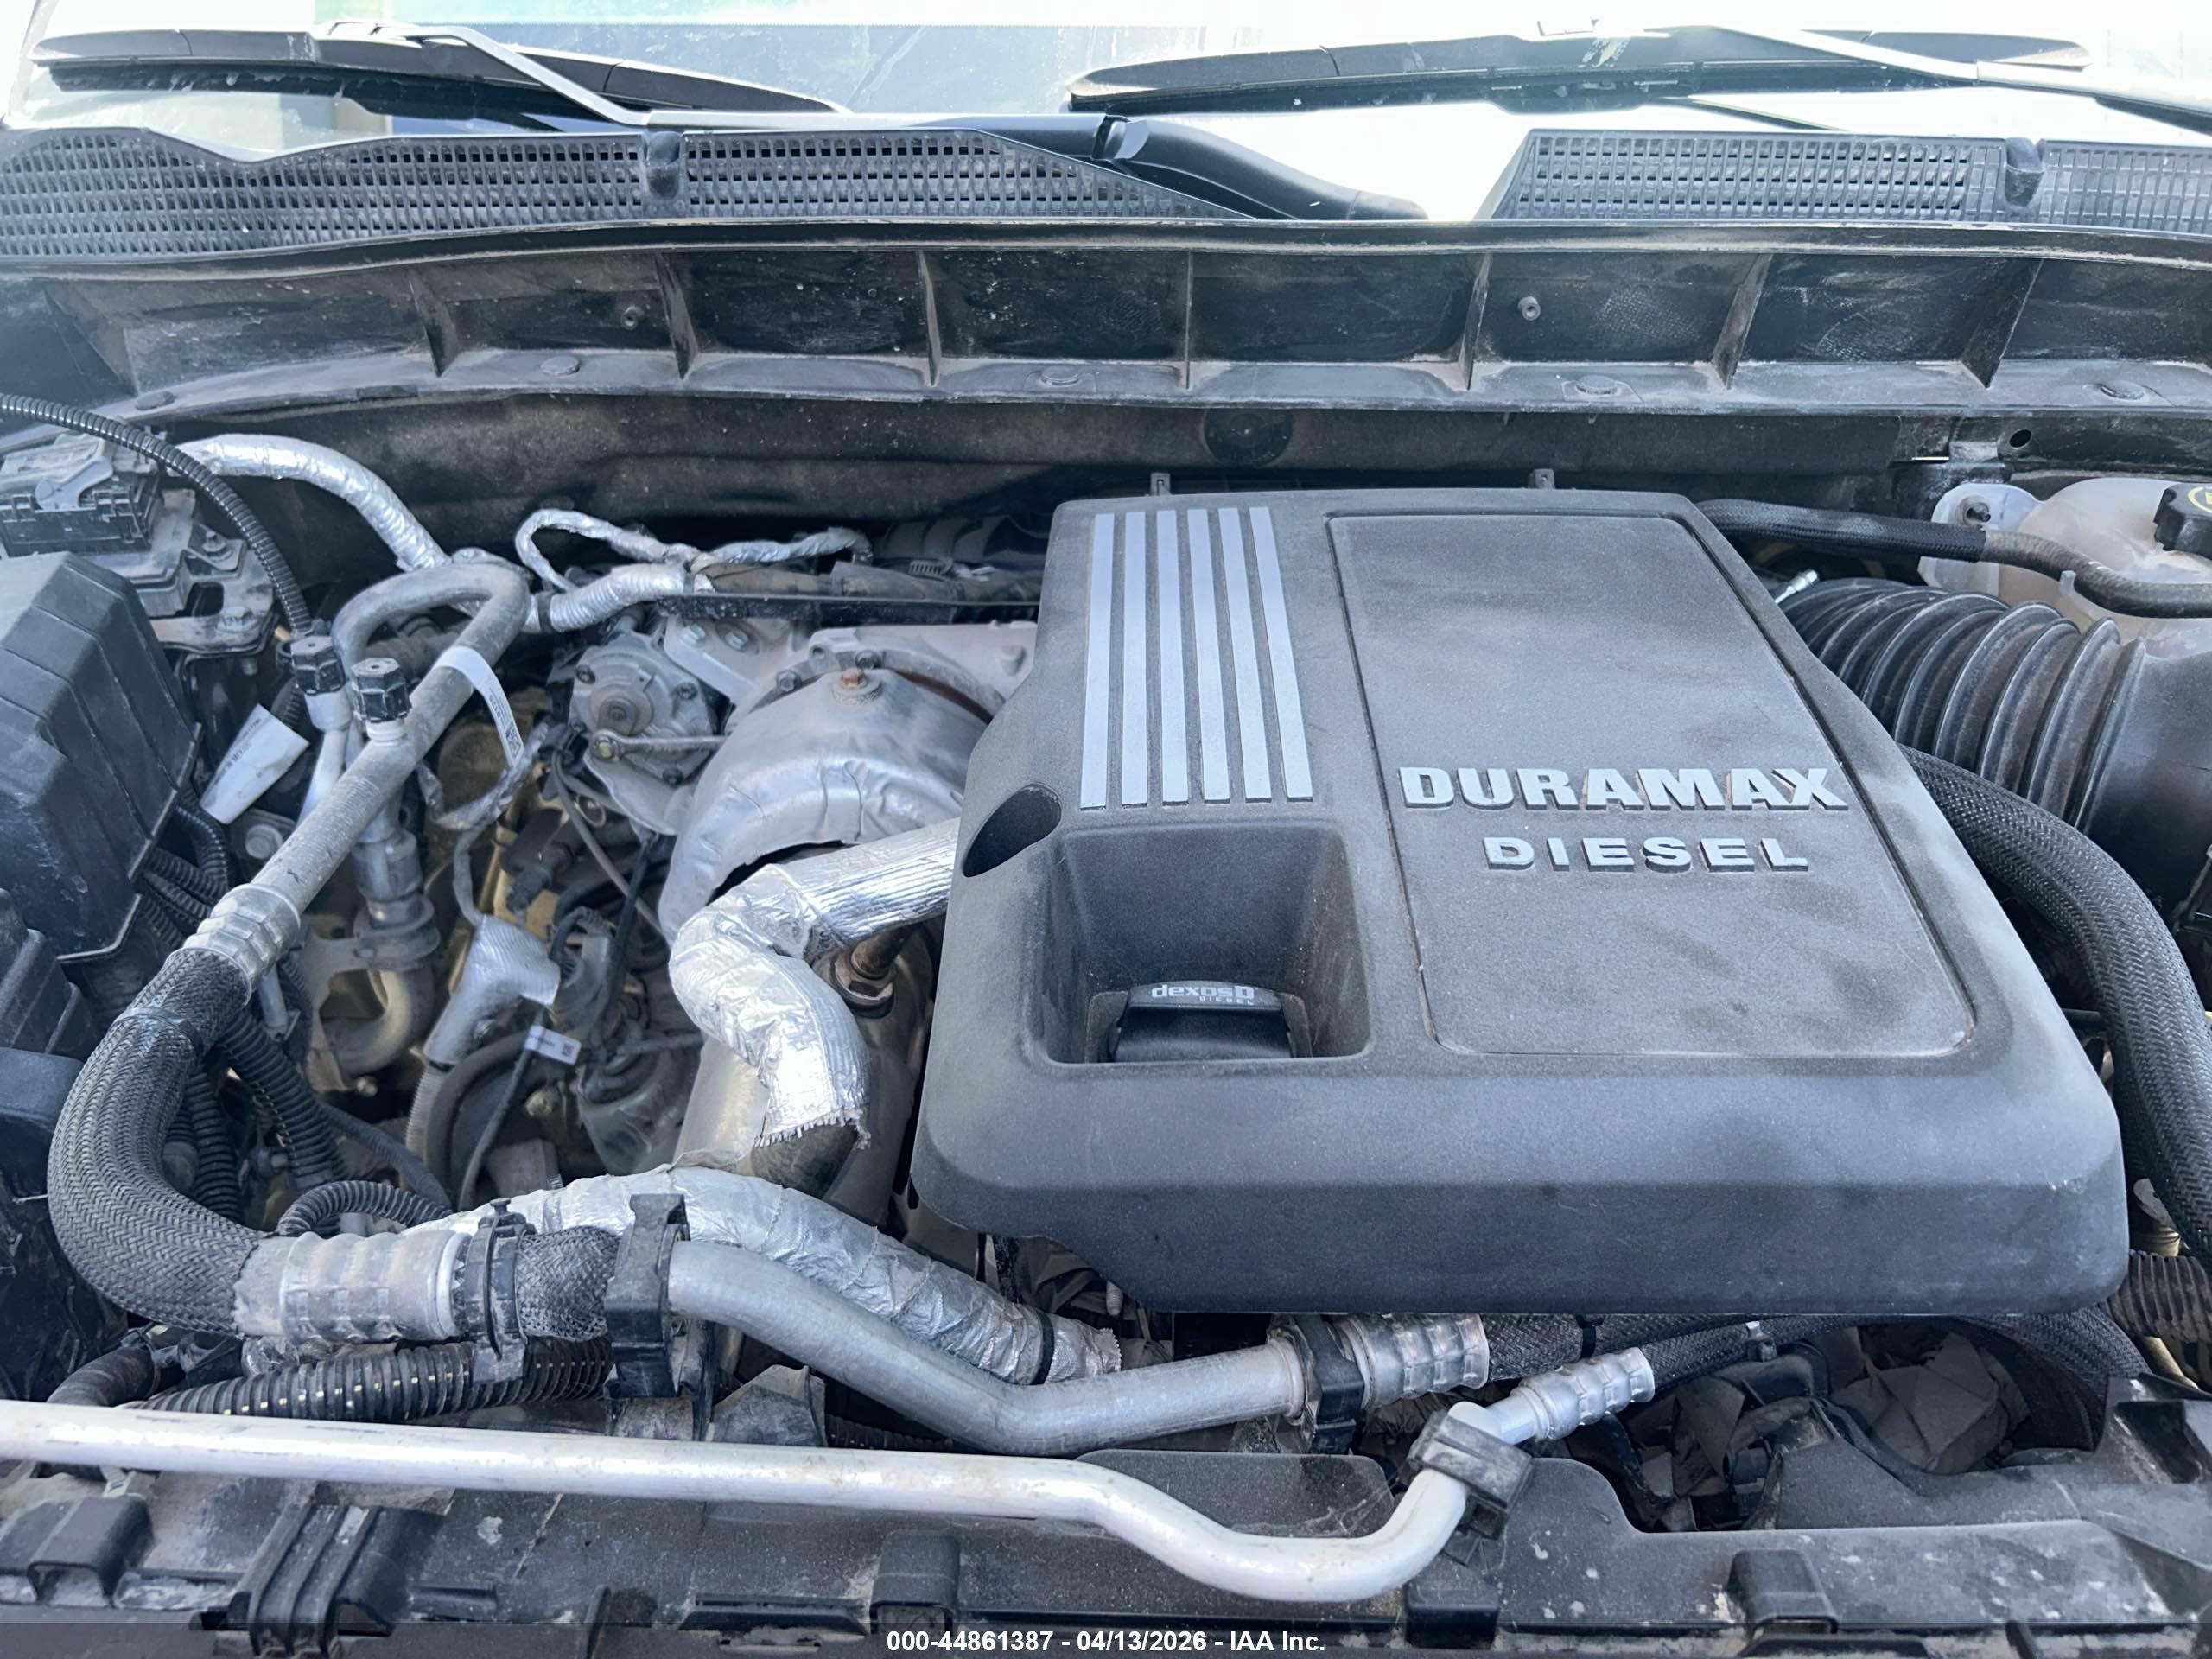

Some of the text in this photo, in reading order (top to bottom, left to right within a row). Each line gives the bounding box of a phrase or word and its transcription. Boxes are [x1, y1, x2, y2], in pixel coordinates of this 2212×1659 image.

[1398, 766, 1848, 811] DURAMAX
[1482, 837, 1808, 873] DIESEL
[1152, 984, 1255, 1000] dexosD
